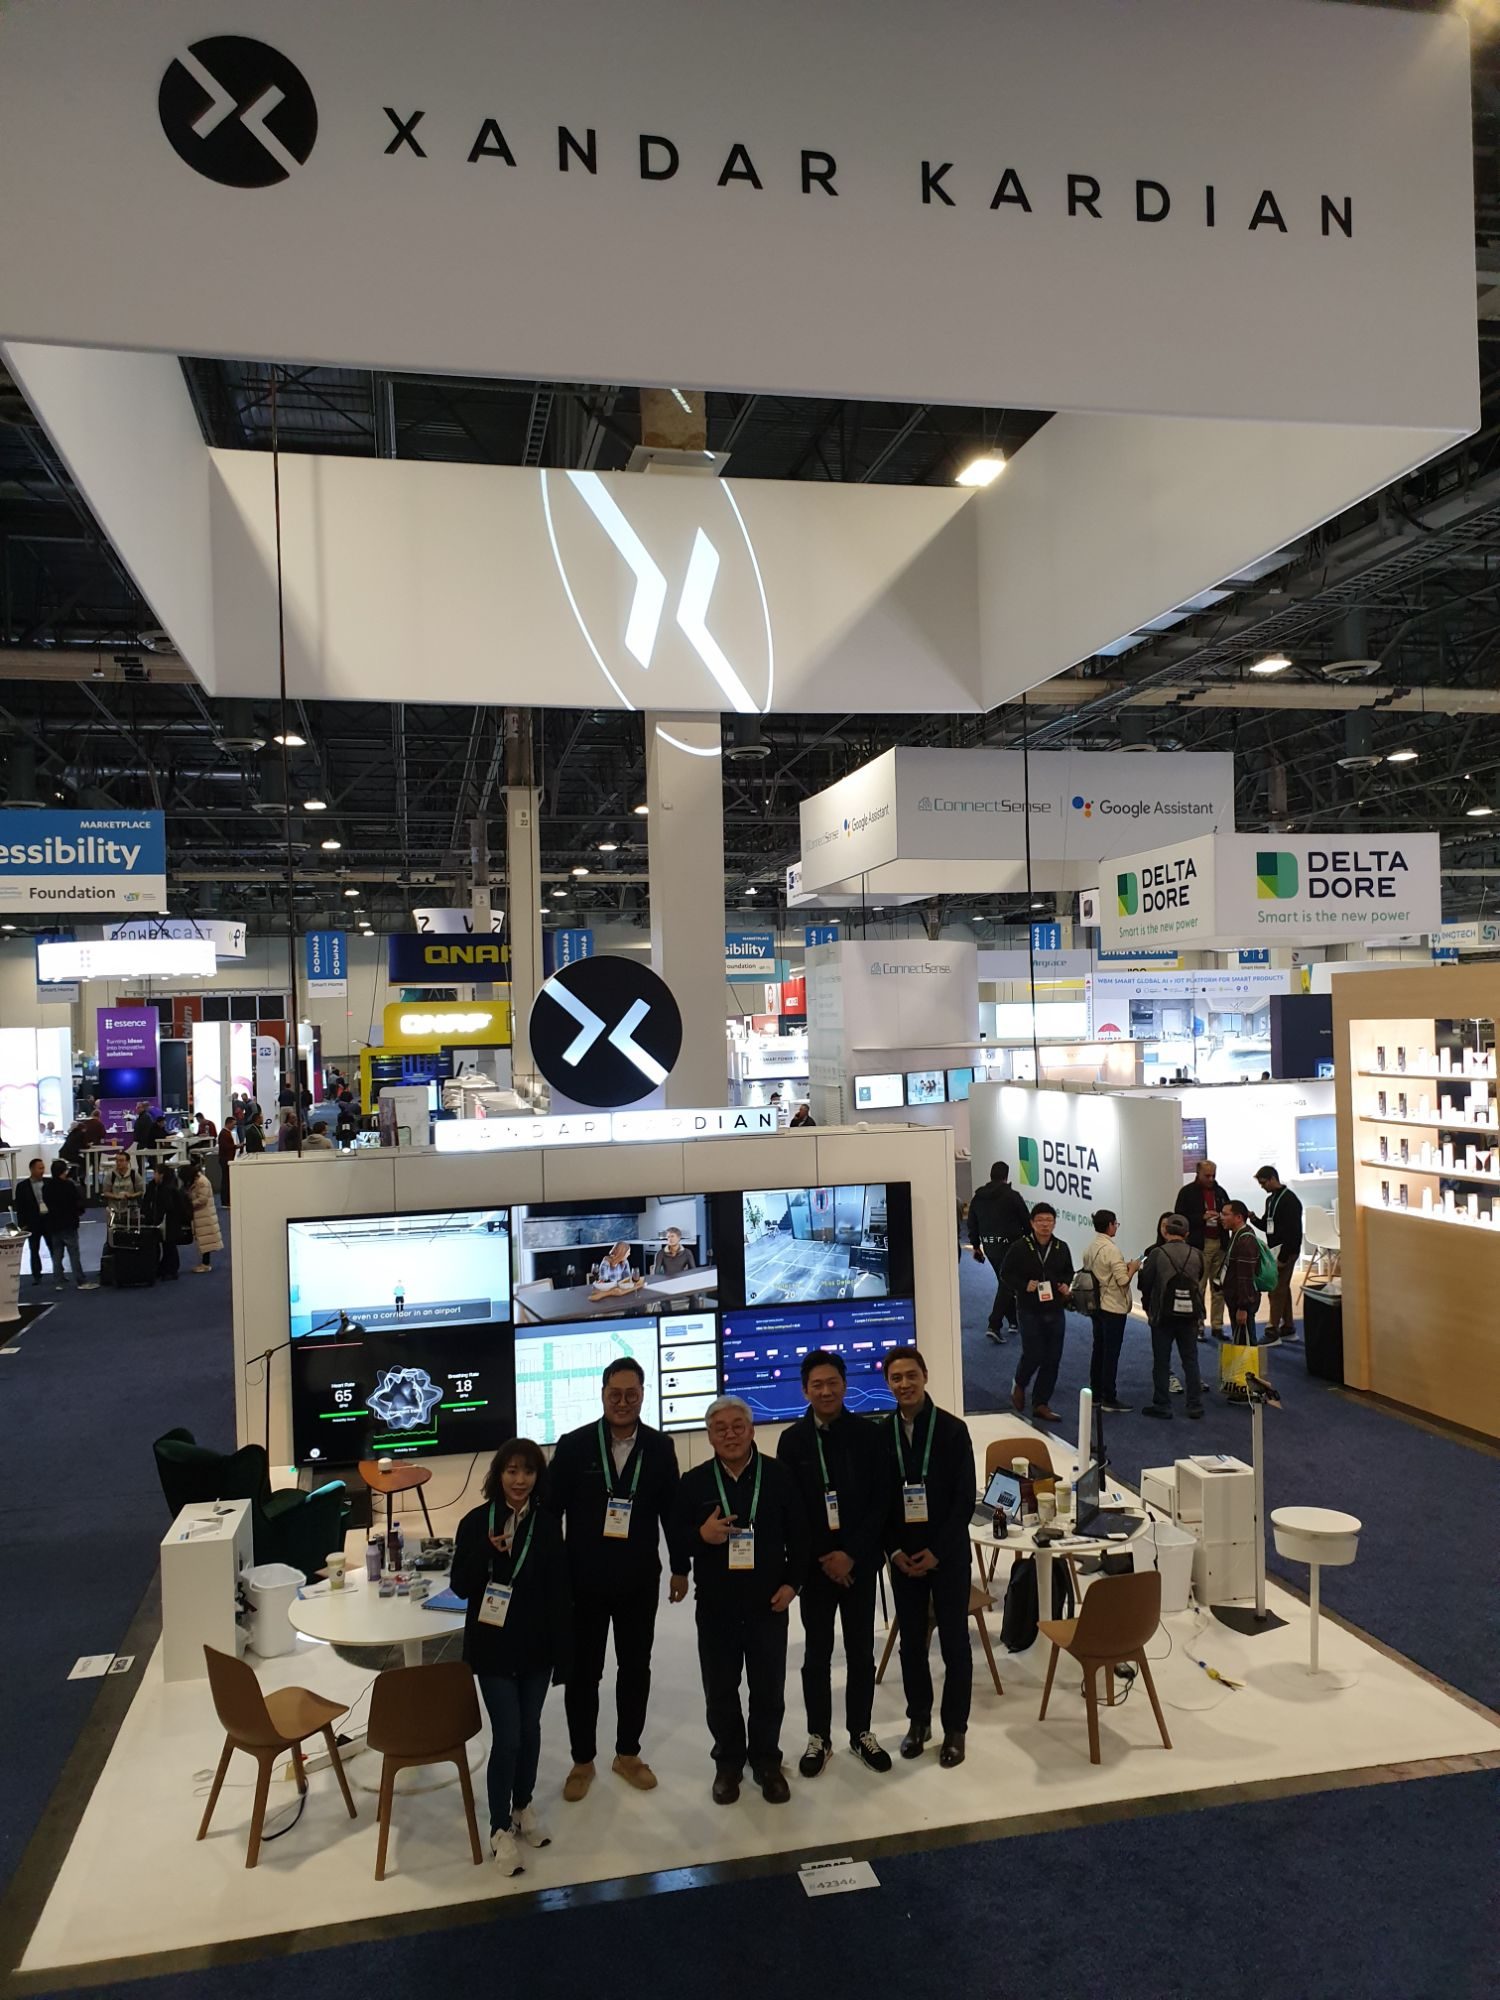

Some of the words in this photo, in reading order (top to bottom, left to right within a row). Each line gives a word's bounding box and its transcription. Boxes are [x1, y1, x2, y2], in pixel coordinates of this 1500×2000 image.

[383, 106, 839, 197] XANDAR
[921, 160, 1353, 239] KARDIAN
[851, 814, 869, 832] Google
[868, 804, 890, 822] Assistant
[934, 797, 1051, 814] ConnectSense
[1099, 799, 1151, 818] Google
[1154, 800, 1214, 815] Assistant
[80, 821, 151, 829] MARKETPLACE
[1308, 851, 1409, 873] DELTA
[1142, 858, 1198, 889] DELTA
[29, 886, 116, 900] Foundation
[1308, 877, 1397, 899] DORE
[1142, 885, 1190, 914] DORE
[1257, 910, 1299, 924] Smart
[1301, 910, 1313, 923] is
[1315, 909, 1338, 923] the
[1341, 912, 1367, 922] new
[1371, 910, 1411, 924] power
[1119, 926, 1140, 939] Smart
[1140, 925, 1147, 935] is
[1147, 923, 1159, 934] the
[1160, 922, 1175, 932] new
[1175, 918, 1199, 933] power
[621, 1112, 772, 1133] DIAN
[1043, 1140, 1099, 1173] DELTA
[1044, 1168, 1093, 1200] DORE
[1062, 1210, 1077, 1222] new
[380, 1311, 411, 1320] corridor
[434, 1306, 461, 1317] airport
[334, 1389, 352, 1403] 65
[455, 1379, 473, 1393] 18
[816, 1877, 857, 1889] 42346
